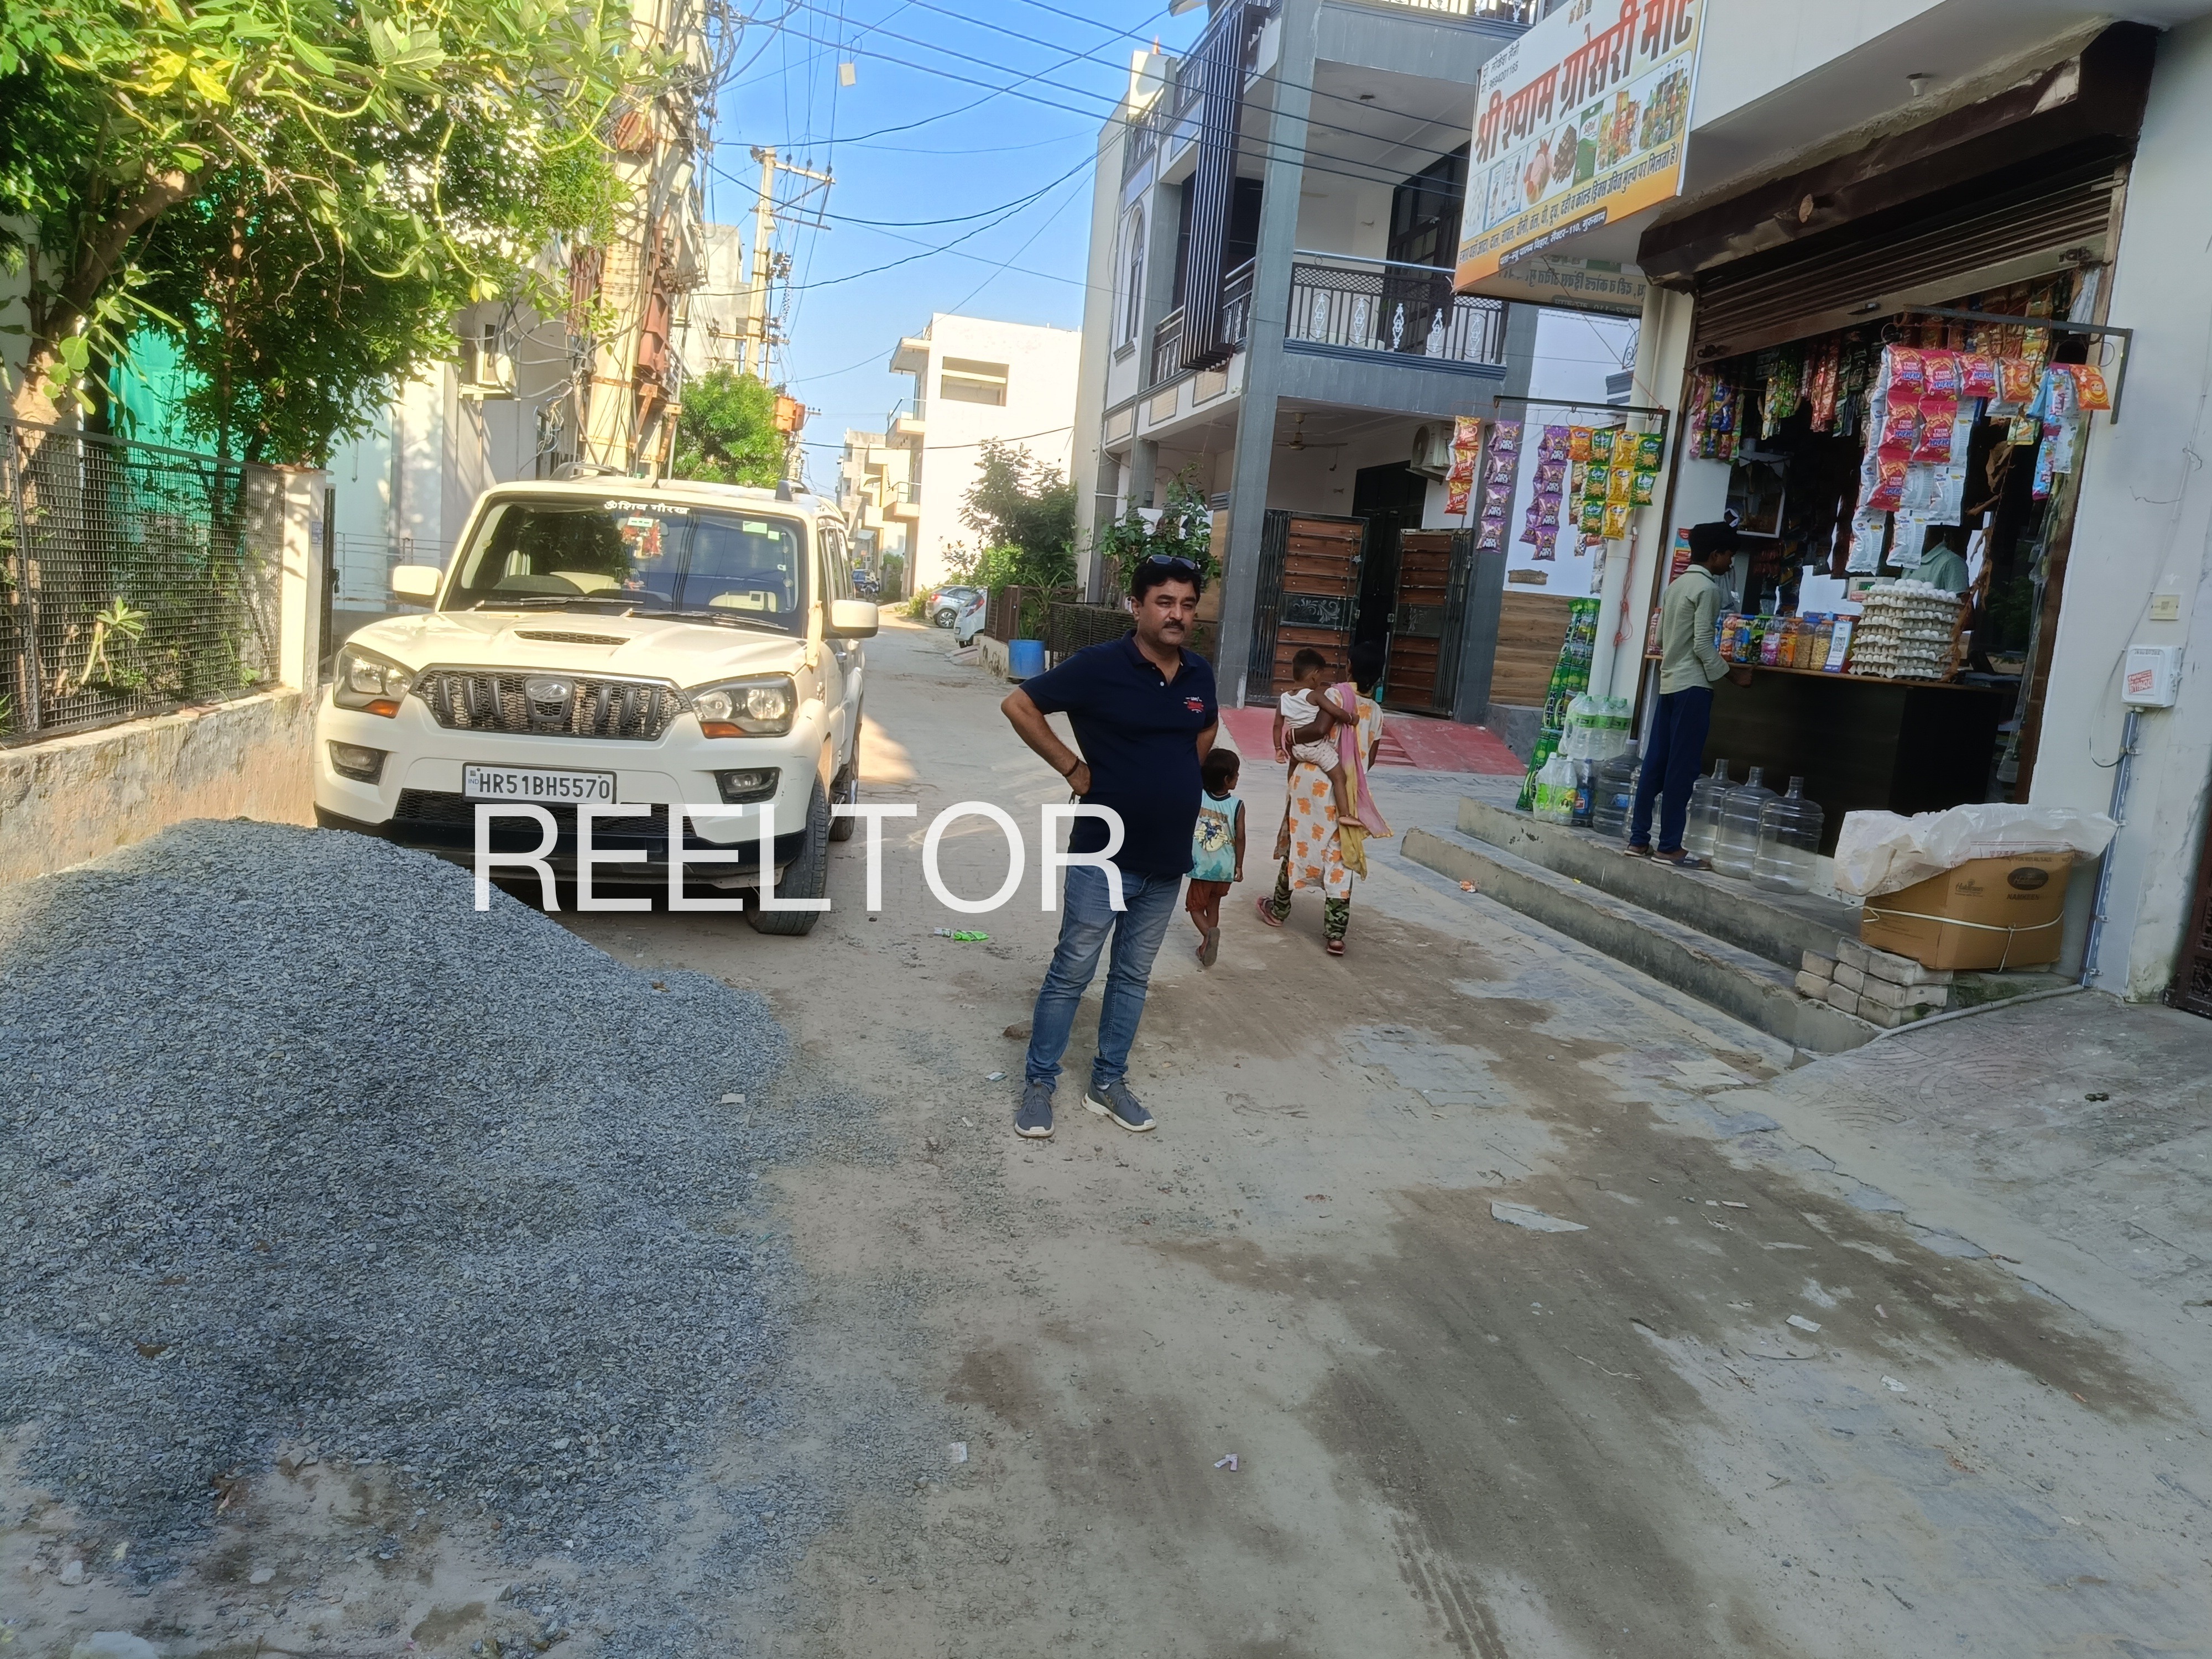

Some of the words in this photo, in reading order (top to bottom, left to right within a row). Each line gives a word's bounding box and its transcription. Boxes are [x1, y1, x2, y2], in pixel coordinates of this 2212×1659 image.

[1475, 89, 1504, 164] श्री
[1502, 63, 1561, 150] श्याम
[1559, 0, 1641, 119] ग्रोसरी
[1638, 160, 1648, 179] पर
[1647, 152, 1671, 176] मिलता
[1545, 691, 1557, 726] KIRTI
[479, 773, 611, 799] HR51BH5570
